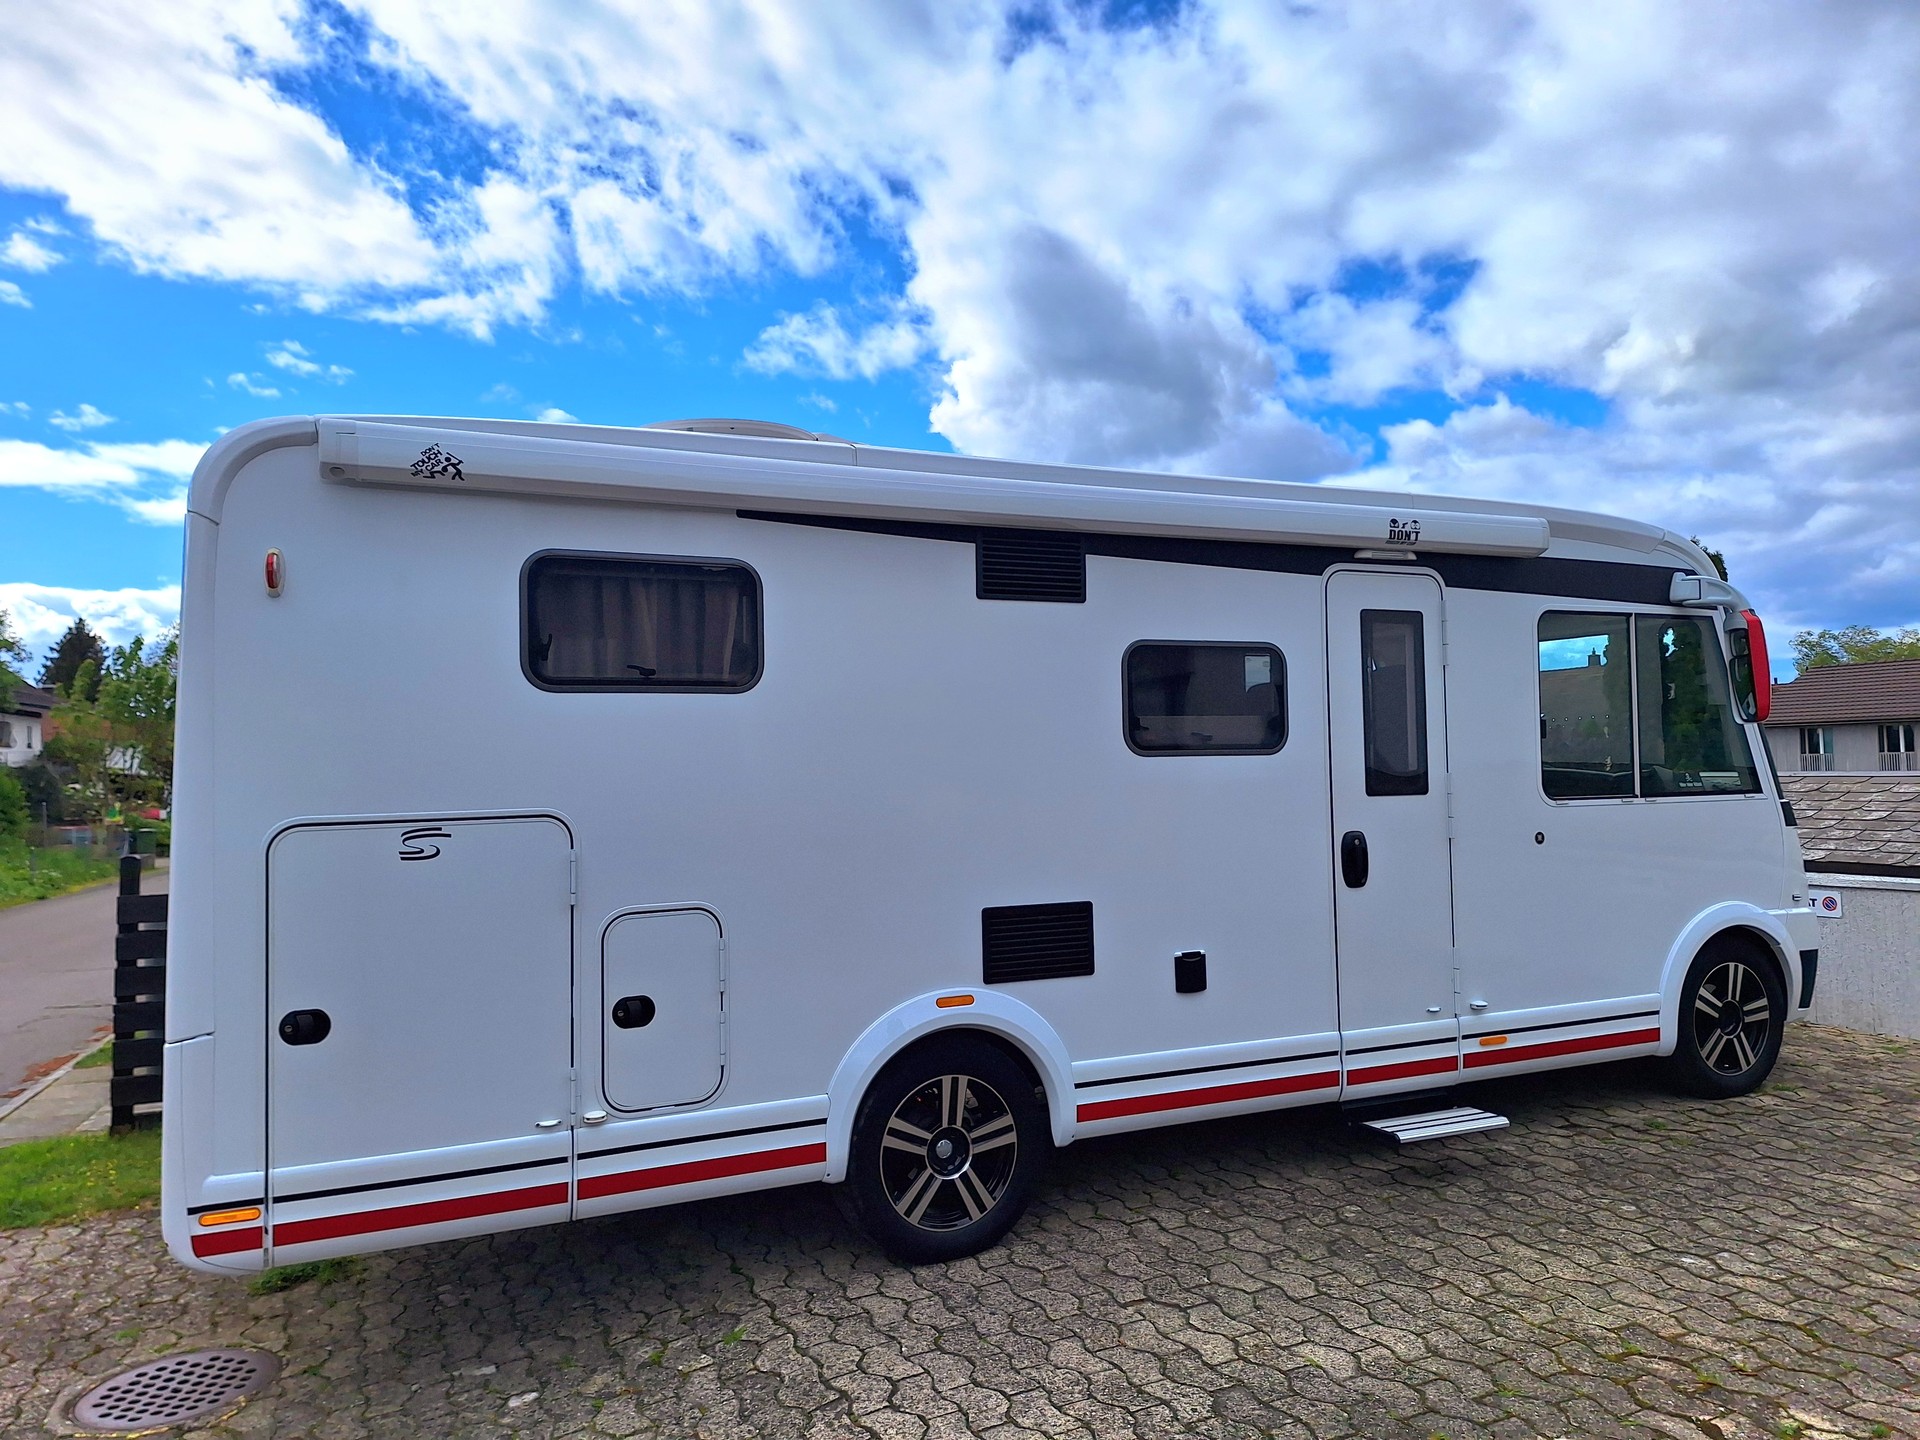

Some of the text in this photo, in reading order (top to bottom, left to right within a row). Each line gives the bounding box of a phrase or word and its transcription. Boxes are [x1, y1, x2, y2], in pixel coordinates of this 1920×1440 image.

[420, 442, 440, 457] DON'T
[410, 449, 443, 470] TOUCH
[425, 458, 444, 472] CAR
[1388, 529, 1421, 542] DON'T
